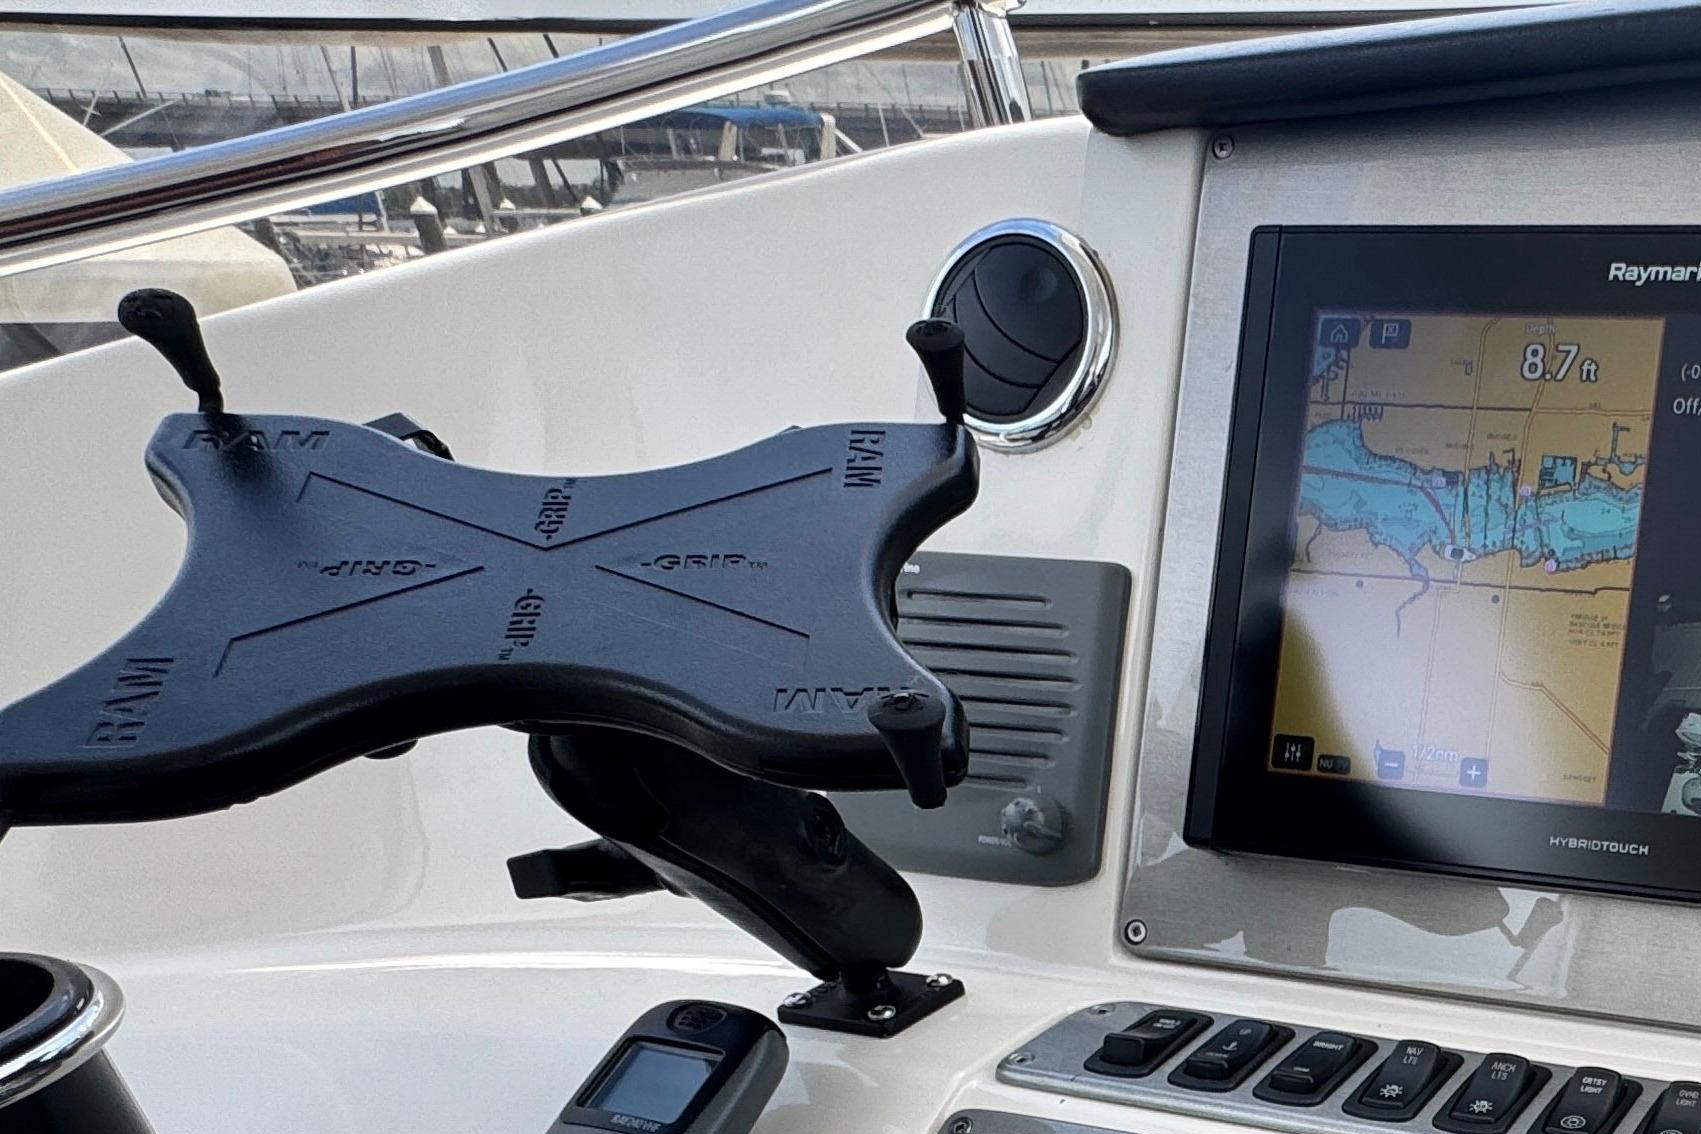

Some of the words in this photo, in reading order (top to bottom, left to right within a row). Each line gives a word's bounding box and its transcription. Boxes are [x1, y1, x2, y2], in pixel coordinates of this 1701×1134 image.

[1521, 344, 1579, 381] 8.7
[1580, 360, 1598, 383] ft
[844, 430, 886, 488] RAM
[83, 657, 175, 749] RAM
[1549, 834, 1650, 858] HYBRIDTOUCH
